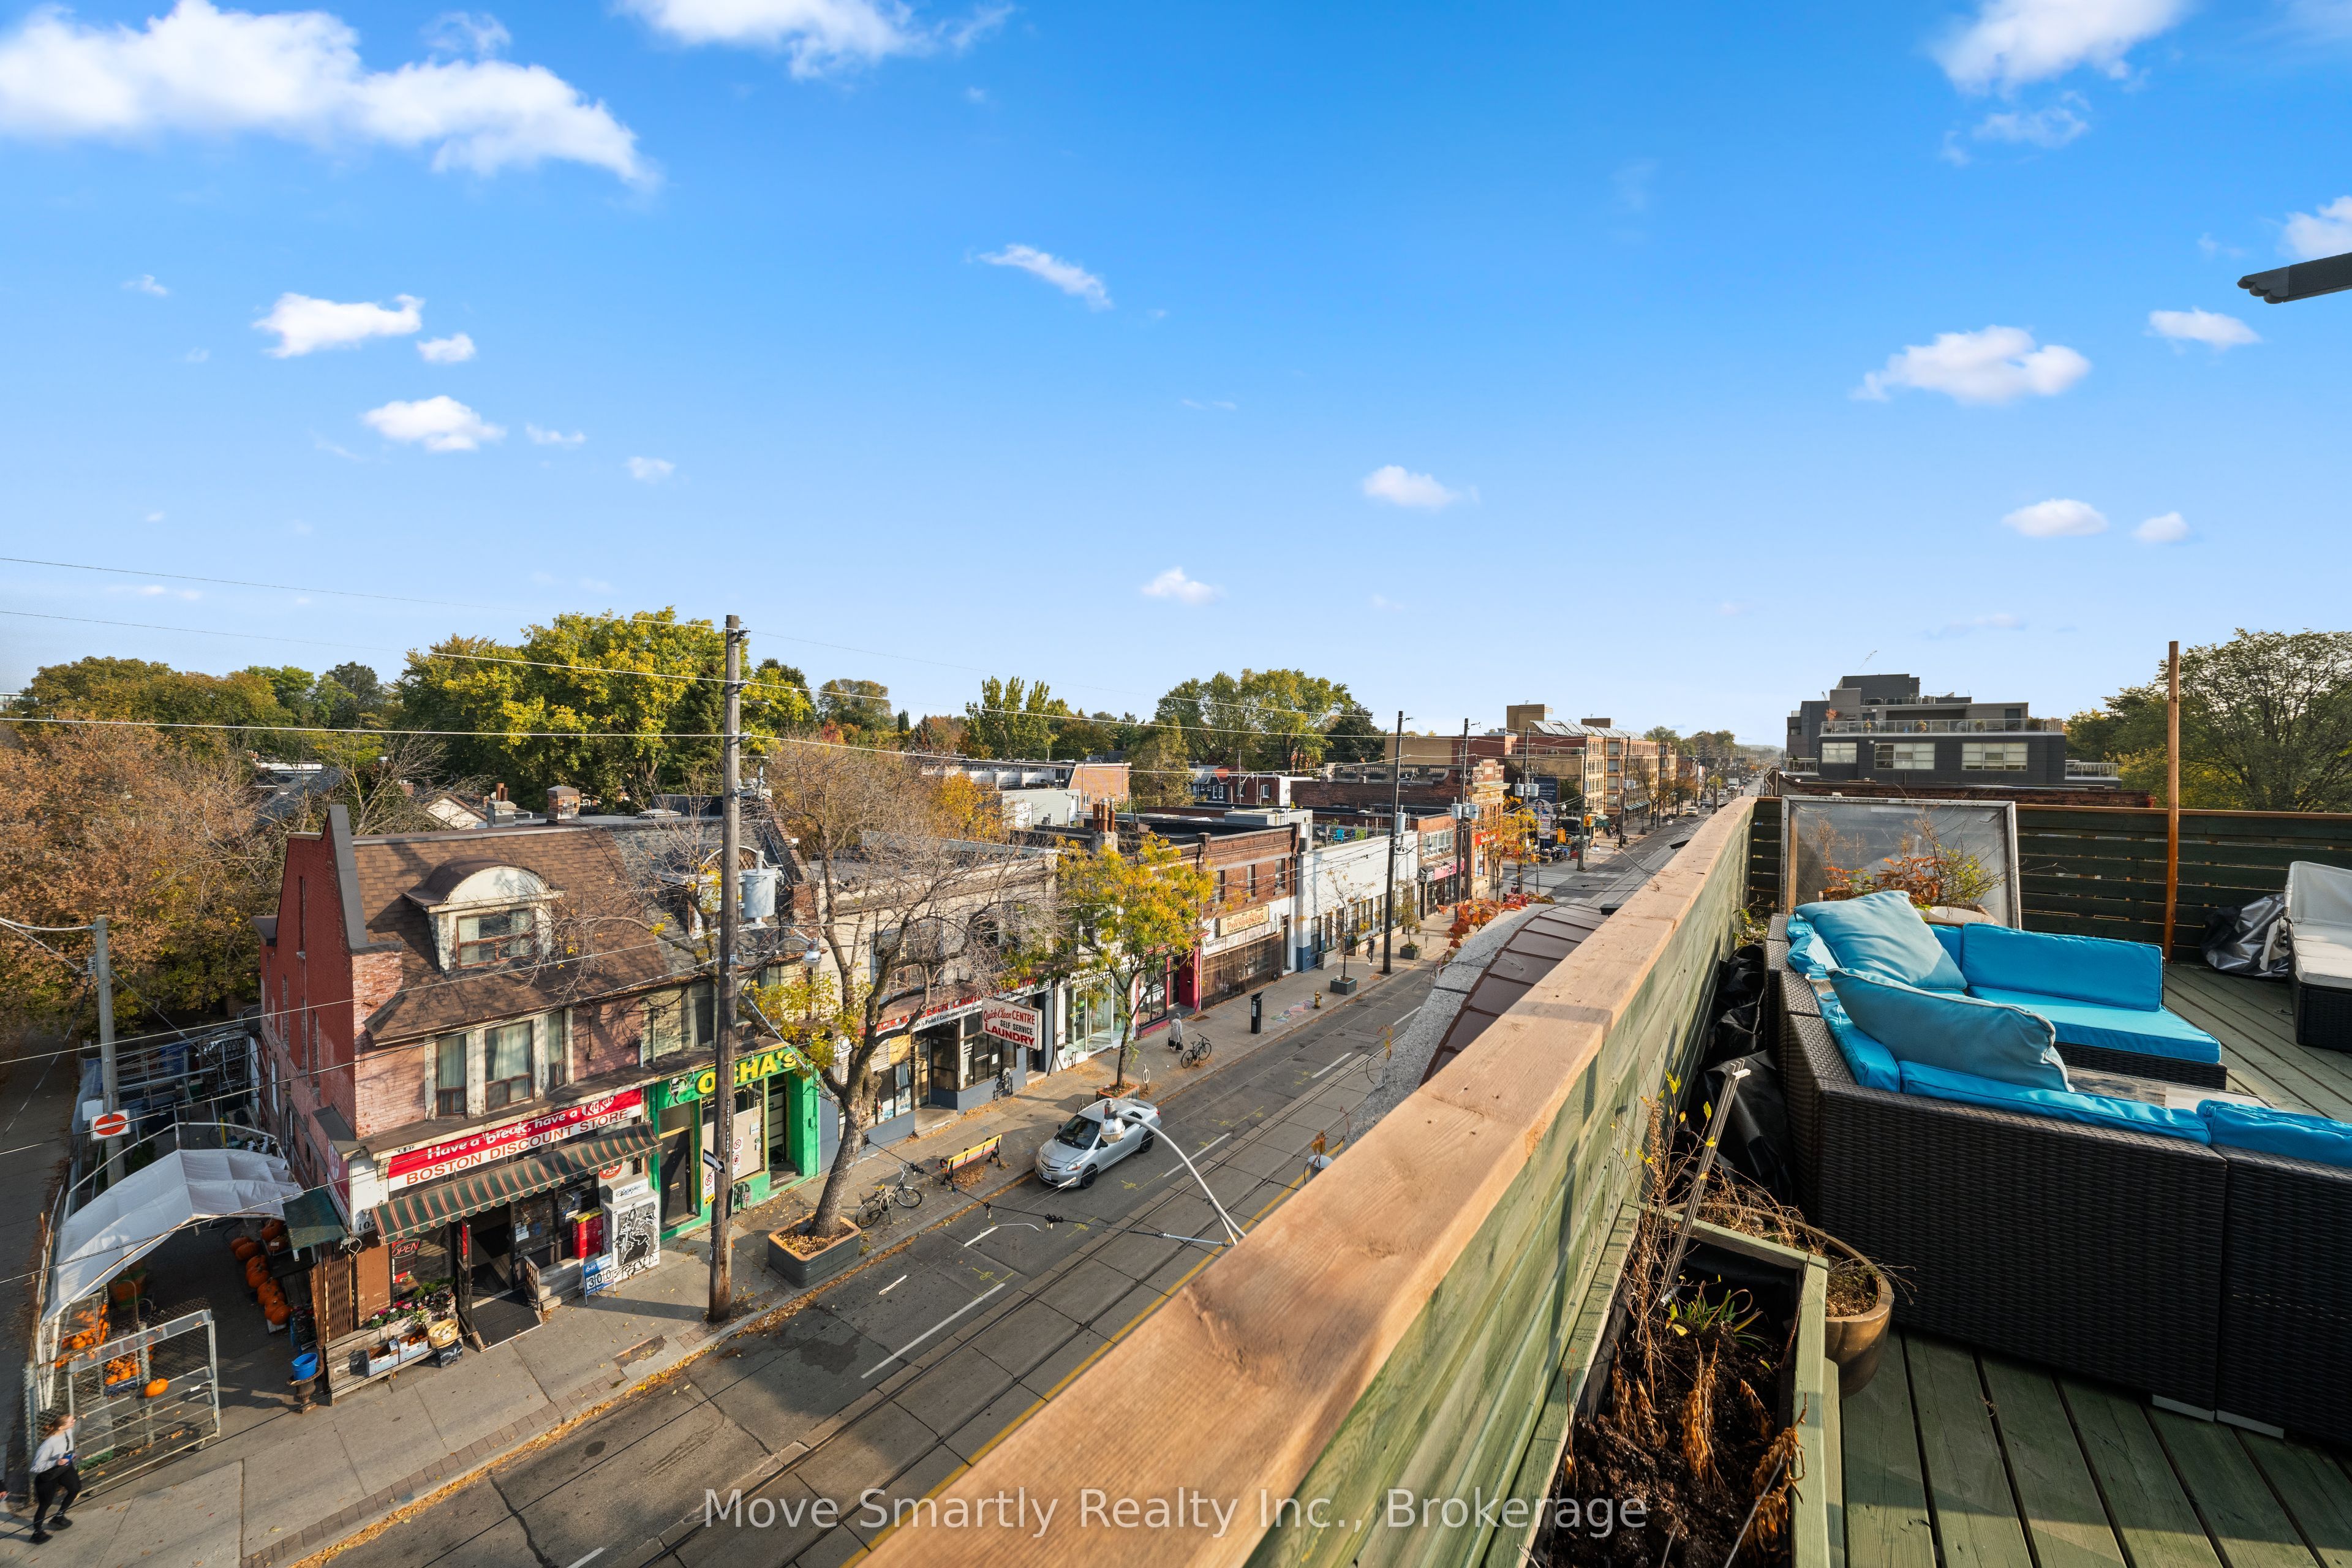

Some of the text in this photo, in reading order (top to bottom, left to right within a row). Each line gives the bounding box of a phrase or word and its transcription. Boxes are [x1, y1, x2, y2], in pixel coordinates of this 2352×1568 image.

[1227, 912, 1264, 931] PAWNBROKERS
[940, 1008, 968, 1020] Commercial
[1012, 1010, 1035, 1025] CENTRE
[985, 1023, 1035, 1046] LAUNDRY
[1000, 1020, 1033, 1036] SELF SERVICE
[428, 1143, 467, 1160] Have
[470, 1138, 480, 1147] a
[535, 1112, 566, 1128] have
[570, 1110, 578, 1118] a
[586, 1096, 614, 1115] KitKat
[407, 1109, 628, 1185] BOSTON DISCOUNT STORE
[392, 1240, 420, 1256] OPEN
